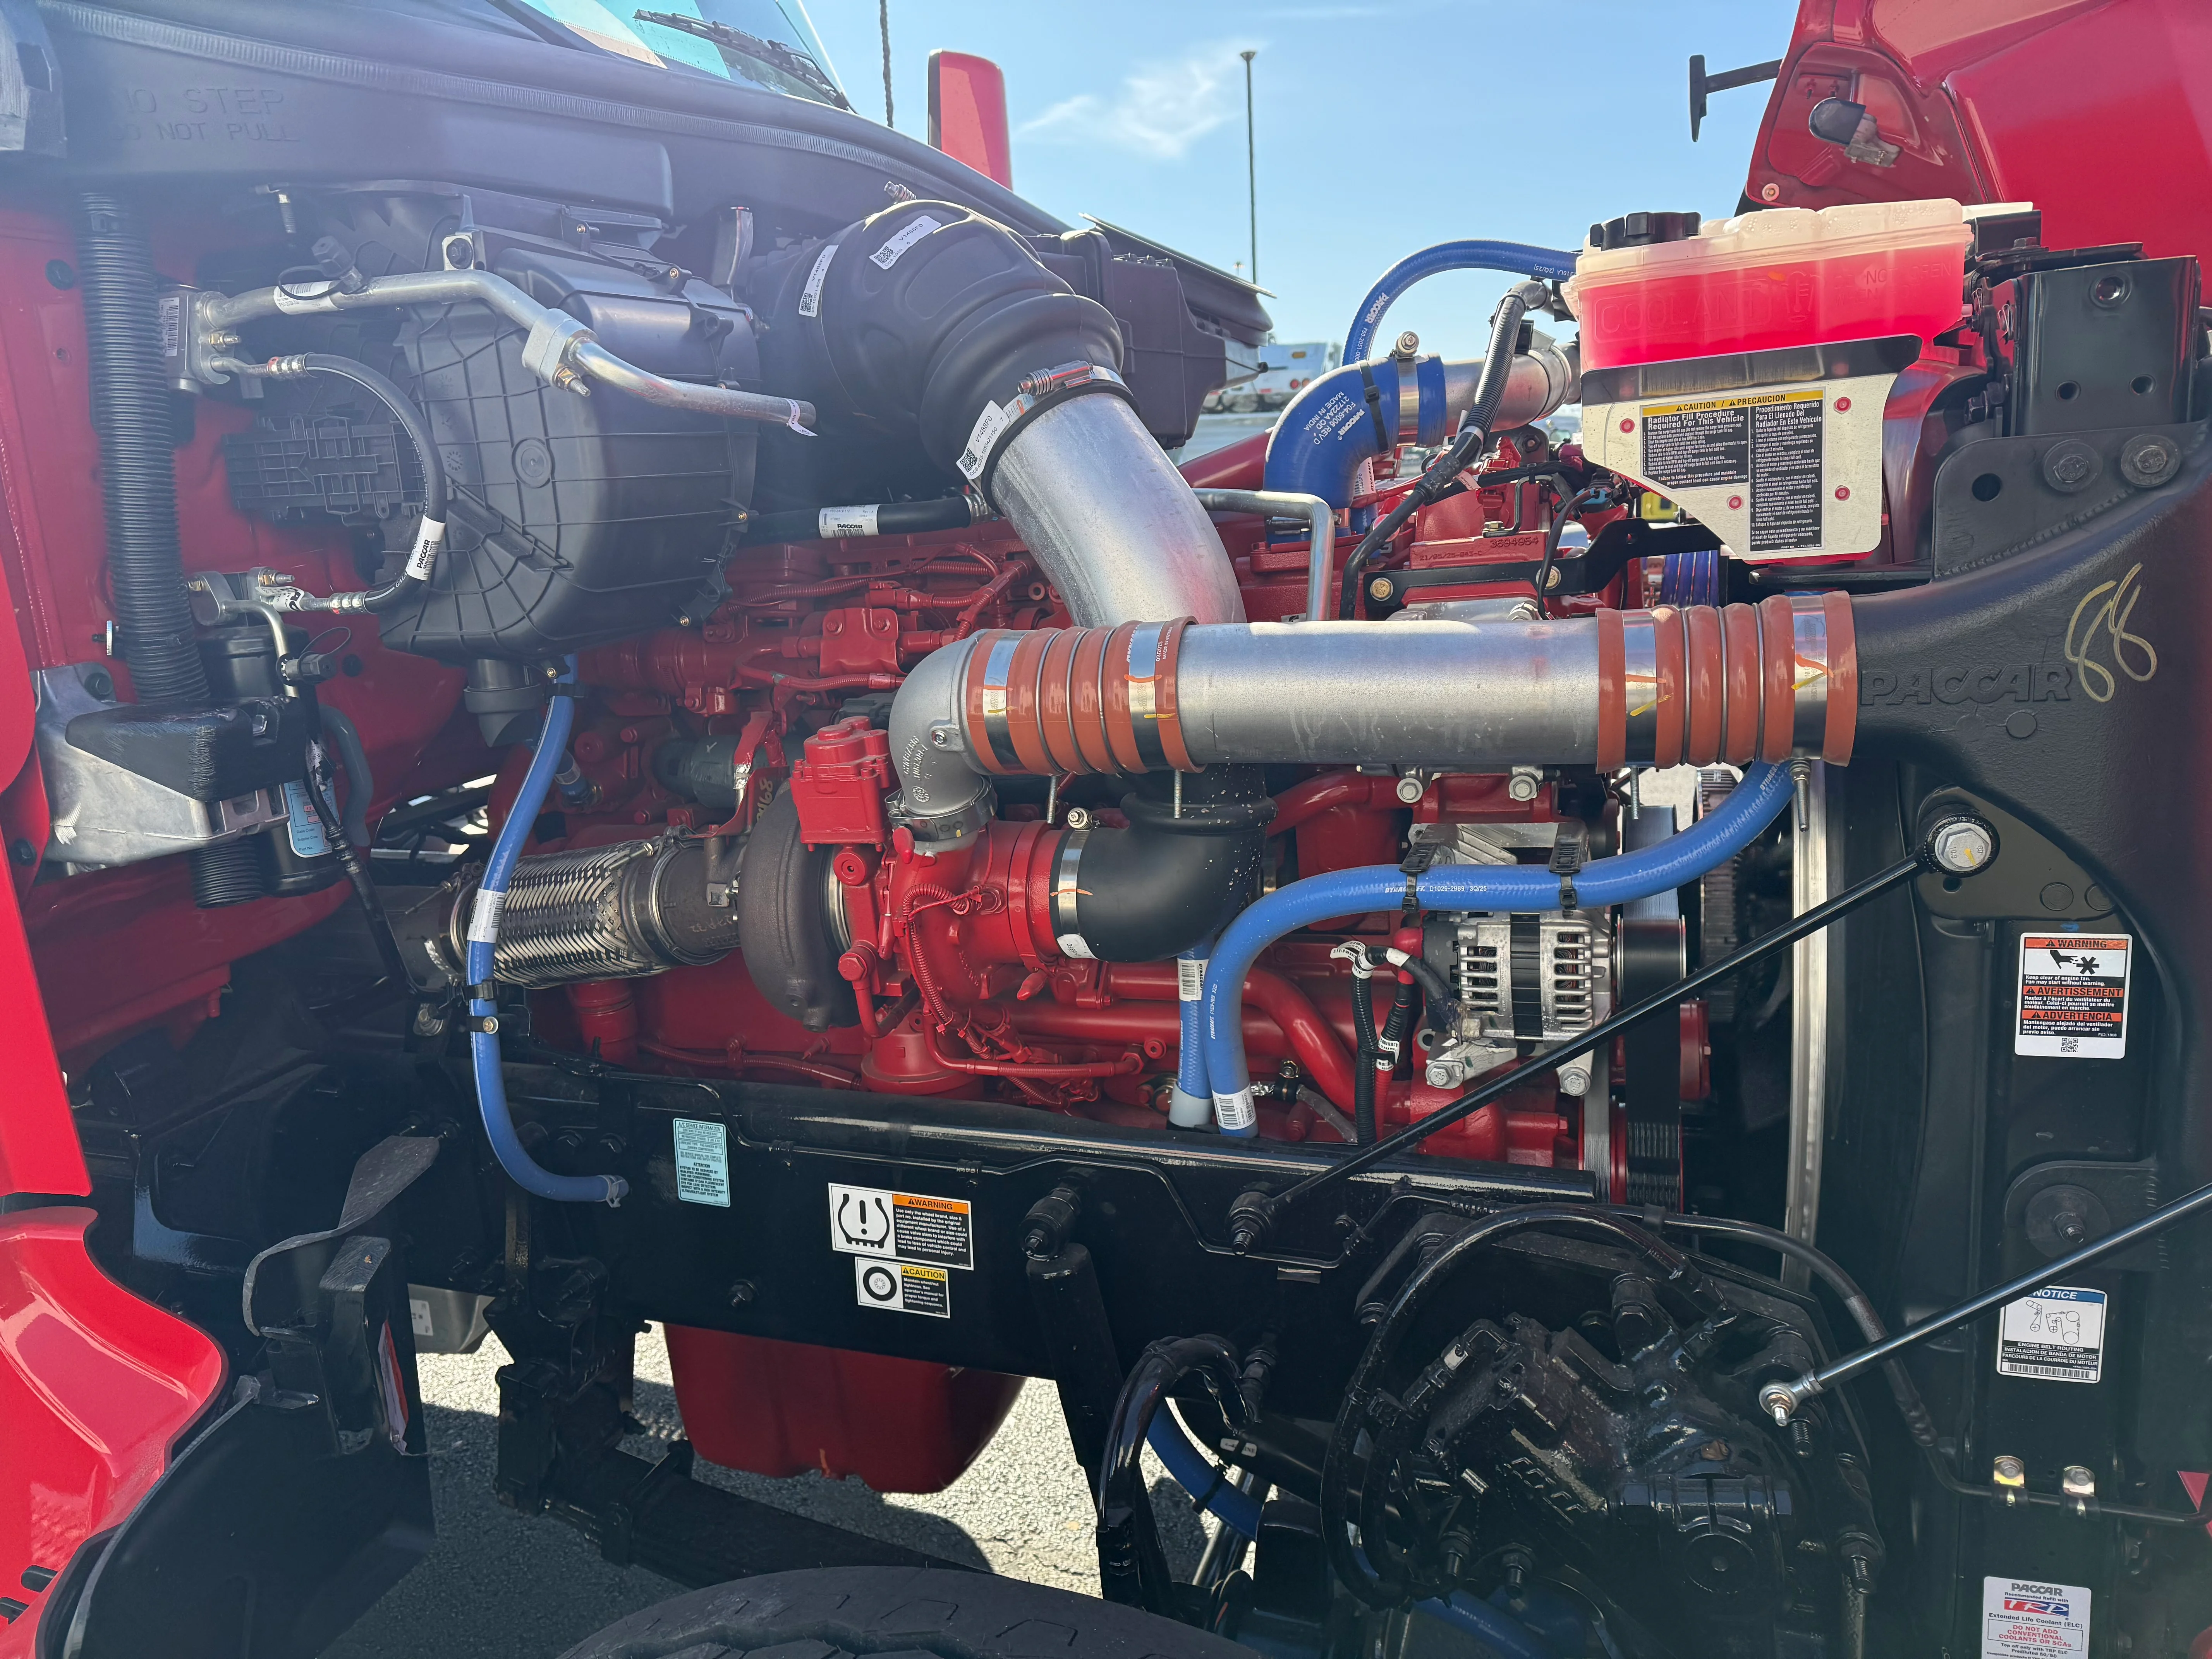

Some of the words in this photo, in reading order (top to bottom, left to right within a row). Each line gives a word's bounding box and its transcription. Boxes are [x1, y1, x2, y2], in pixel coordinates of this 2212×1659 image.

[185, 88, 283, 114] STEP
[157, 123, 205, 139] NOT
[227, 123, 300, 141] PULL
[1365, 292, 1389, 323] PACCAR
[1601, 283, 1761, 334] COOLANT
[1324, 396, 1349, 419] 21722AA
[1325, 392, 1344, 409] MADE
[1684, 401, 1716, 410] CAUTION
[1738, 394, 1785, 405] PRECAUCION
[1318, 407, 1326, 416] IN
[1329, 402, 1356, 427] F04-6006
[1756, 404, 1792, 413] Procedimiento
[1304, 414, 1320, 431] INDIA
[1648, 415, 1680, 424] Radiator
[1696, 410, 1734, 419] Procedure
[1648, 421, 1681, 430] Required
[1716, 415, 1744, 423] Vehicle
[1800, 416, 1822, 424] Vehiculo
[975, 416, 992, 443] V1488F0
[1319, 426, 1331, 440] REV
[1490, 536, 1539, 548] 3694954
[417, 539, 430, 568] PACCAR
[1860, 663, 2072, 706] PACCAR
[2037, 987, 2121, 996] AVERTISSEMENT
[2043, 1012, 2112, 1020] ADVERTENCIA
[915, 1199, 953, 1210] WARNING
[910, 1269, 945, 1279] CAUTION
[2033, 1290, 2078, 1299] NOTICE
[2011, 1583, 2063, 1597] PACCAR
[1999, 1634, 2037, 1643] COOLANTS
[2008, 1630, 2063, 1641] CONVENTIONAL
